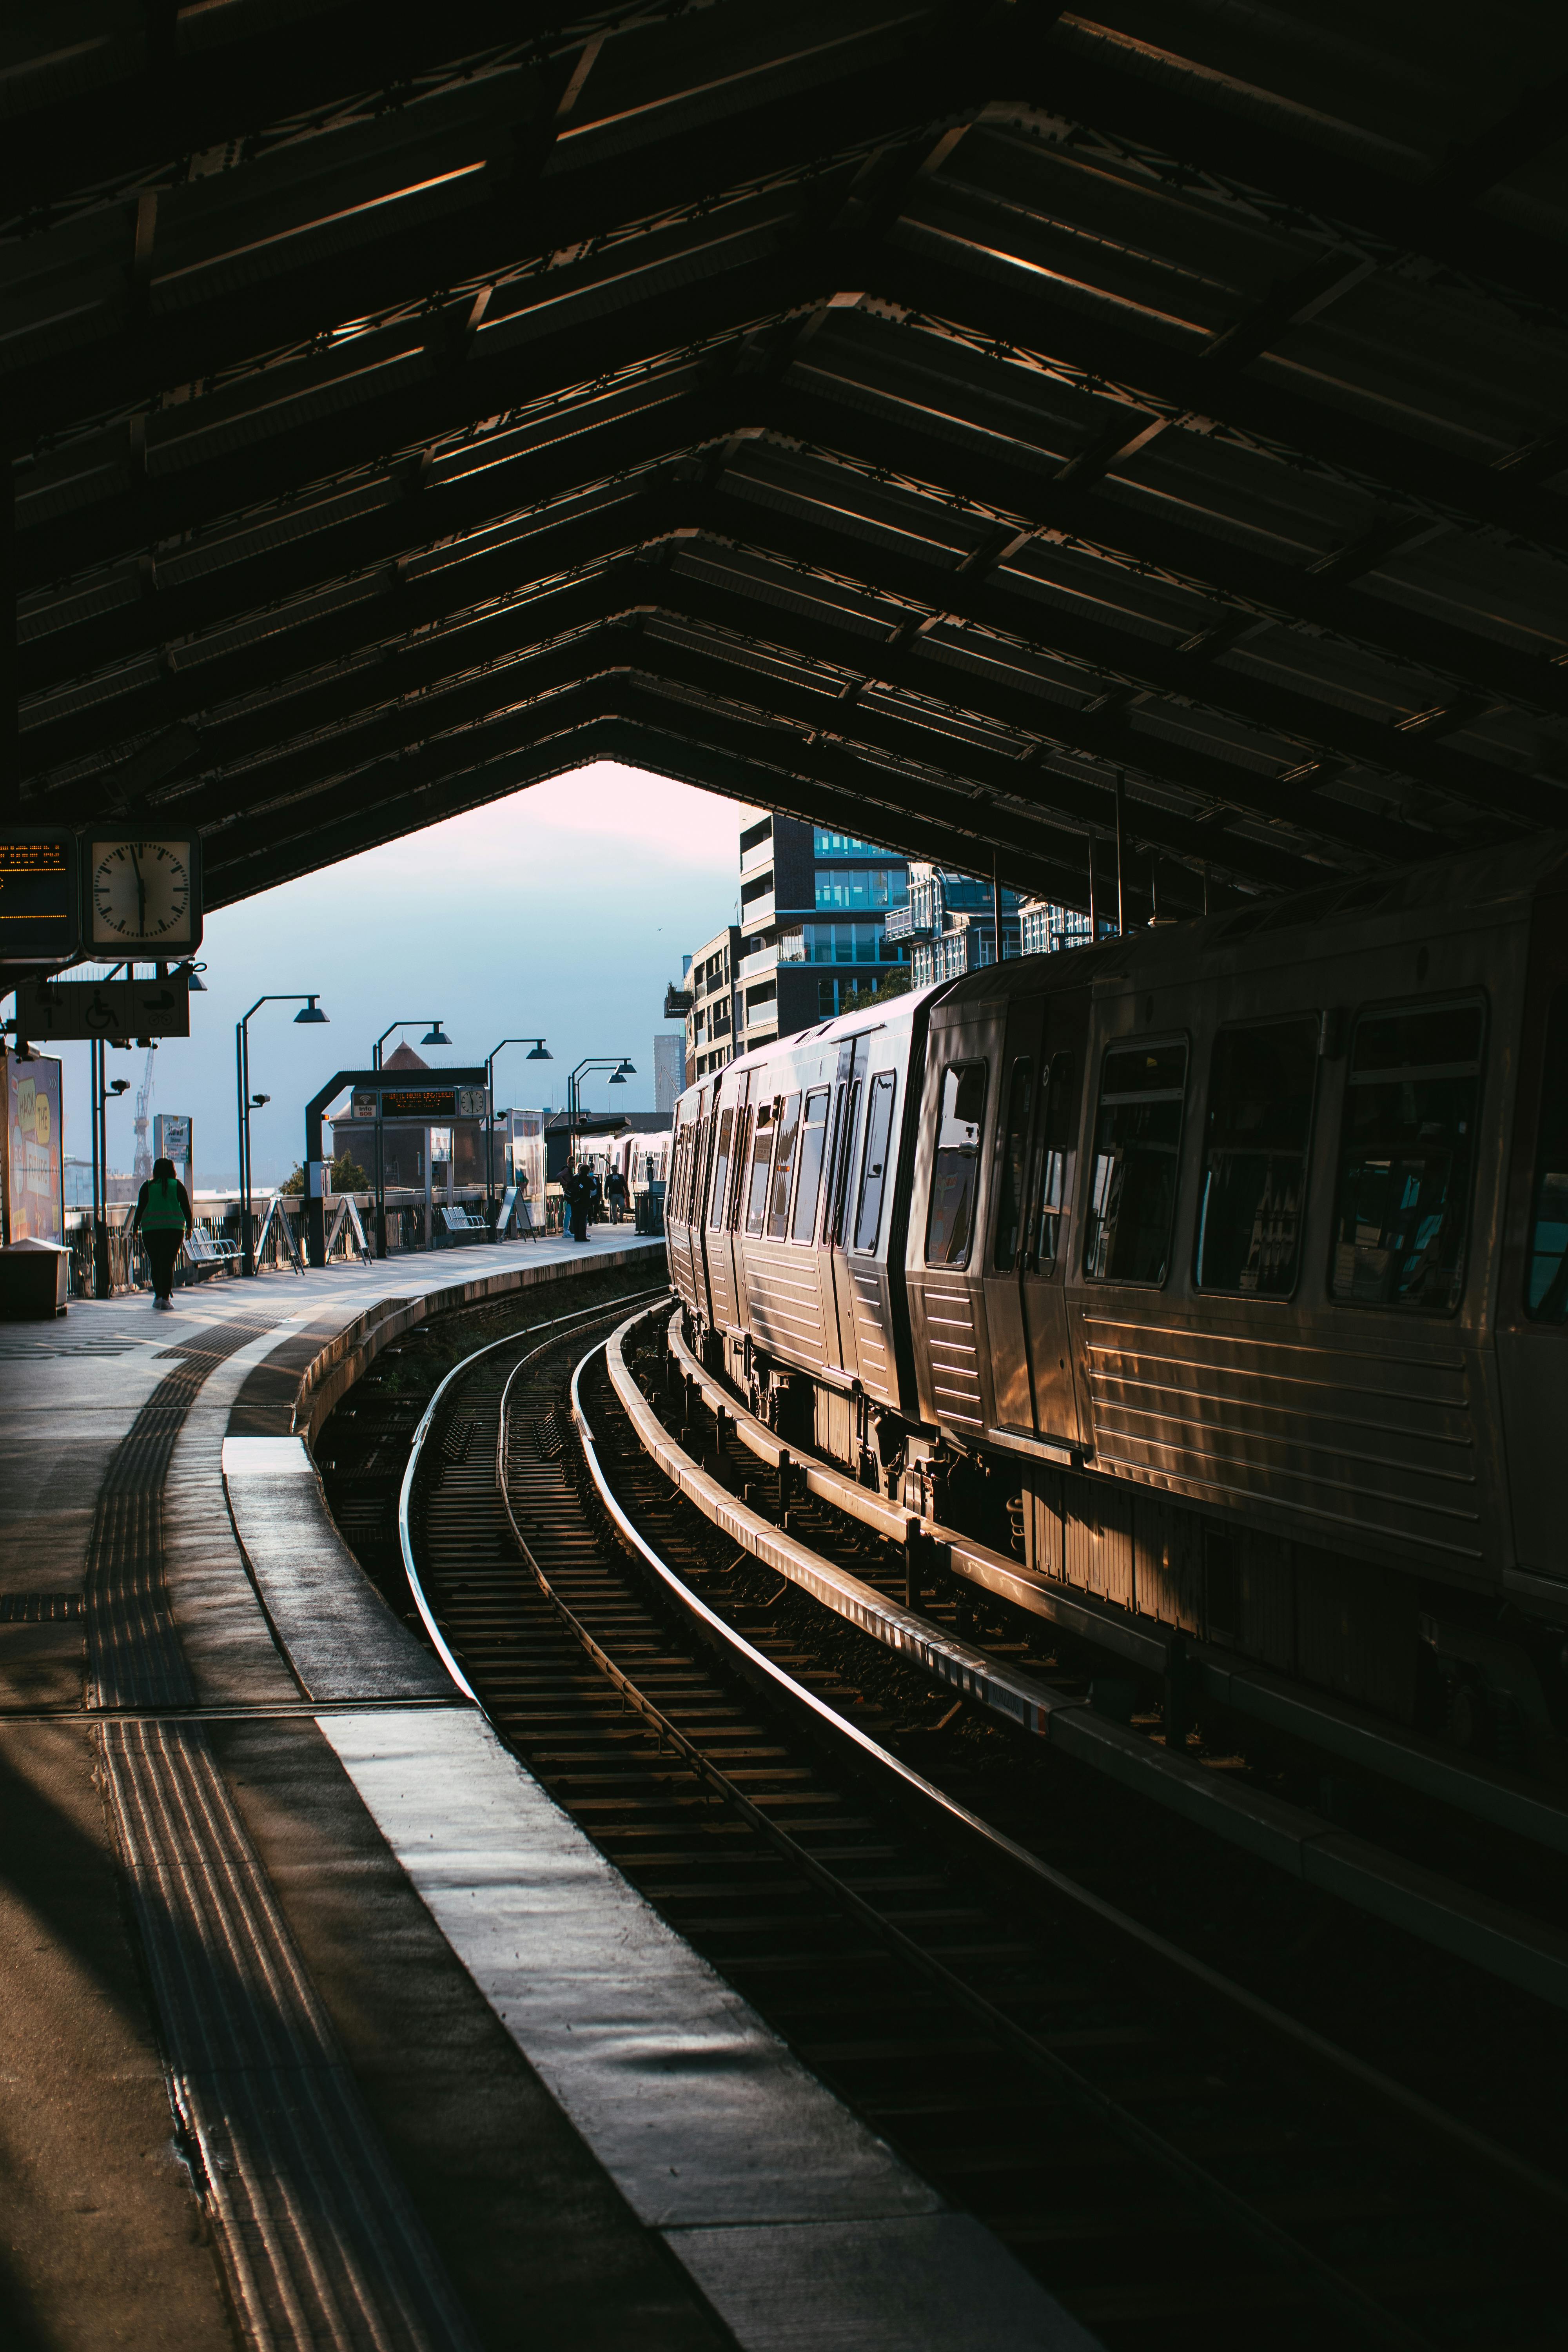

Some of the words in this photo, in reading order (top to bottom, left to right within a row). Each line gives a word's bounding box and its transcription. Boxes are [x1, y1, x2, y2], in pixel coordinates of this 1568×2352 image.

[43, 1006, 53, 1029] 1
[19, 1091, 35, 1119] HACK
[37, 1107, 48, 1131] THE
[28, 1155, 48, 1184] FUTURE
